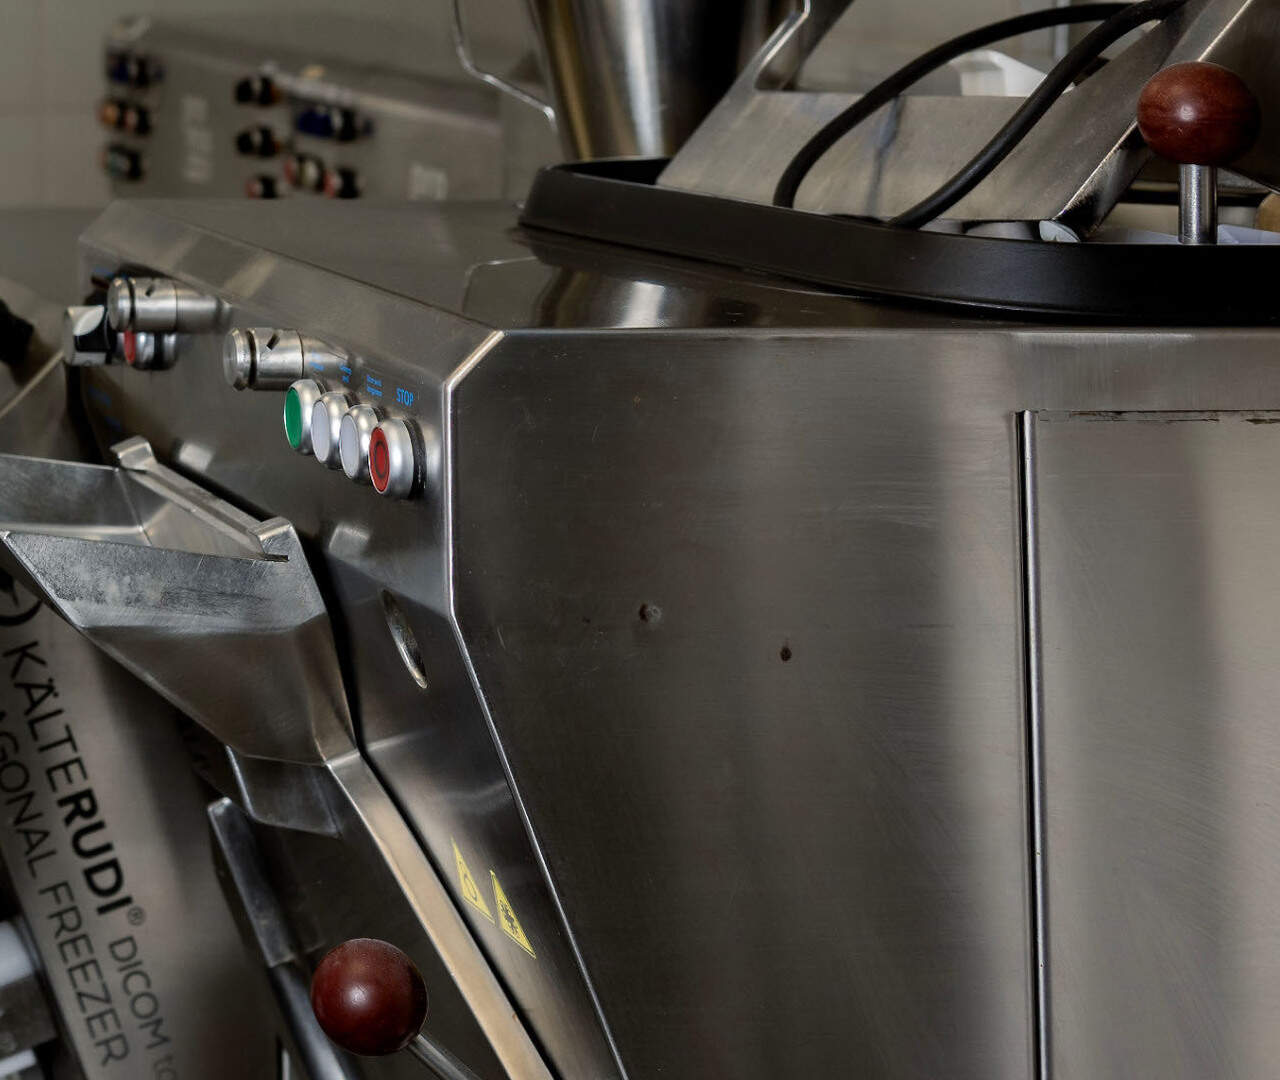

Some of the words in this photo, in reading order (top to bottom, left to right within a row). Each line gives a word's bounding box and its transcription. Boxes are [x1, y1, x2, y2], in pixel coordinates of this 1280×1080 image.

[396, 387, 414, 407] STOP
[37, 881, 130, 1067] FREEZER
[108, 935, 170, 1050] DICOM
